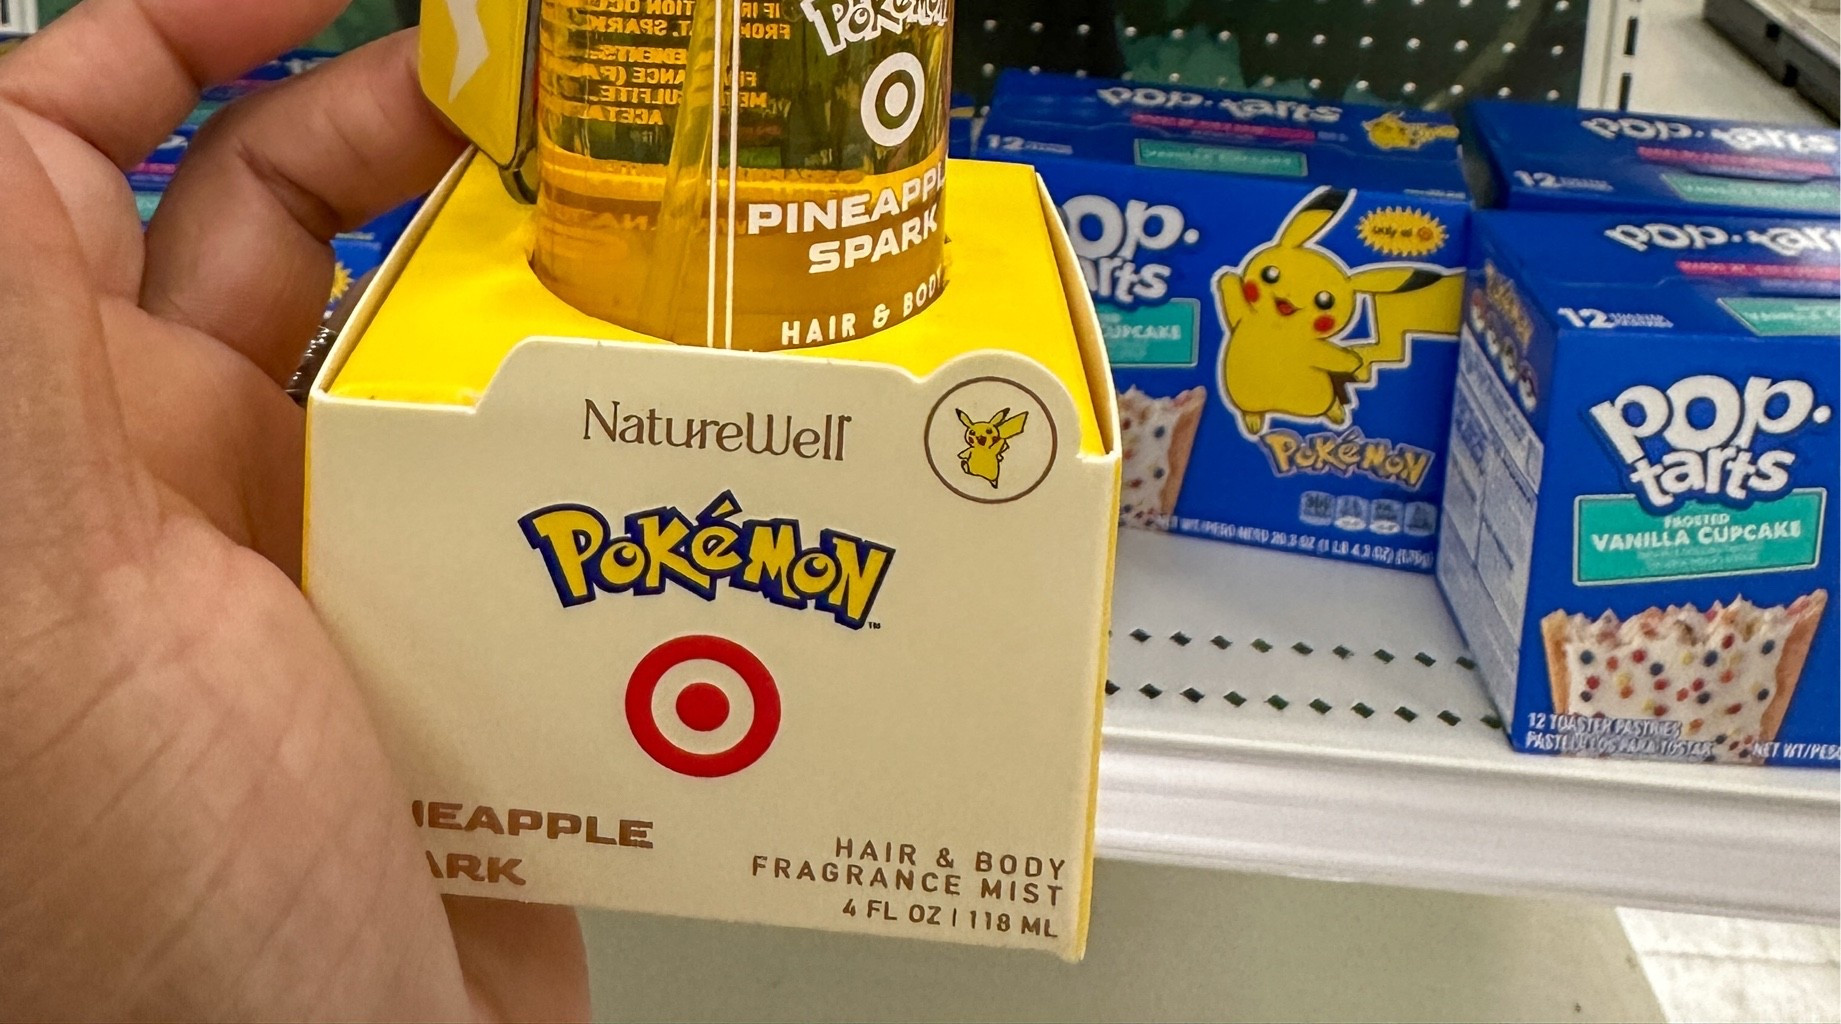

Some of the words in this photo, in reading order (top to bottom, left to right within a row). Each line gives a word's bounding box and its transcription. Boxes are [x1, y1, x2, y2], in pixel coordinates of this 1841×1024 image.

[747, 162, 947, 235] PINEAPPL
[808, 204, 938, 274] SPARK
[781, 312, 856, 346] HAIR
[872, 304, 890, 329] &
[1557, 307, 1613, 330] 12
[583, 398, 852, 462] NatureWell
[1258, 426, 1435, 493] Pokémon
[517, 490, 897, 631] Pokémon
[1590, 529, 1691, 552] VANILLA
[1697, 520, 1802, 544] CUPCAKE
[1527, 712, 1546, 730] 12
[413, 801, 655, 850] EAPPLE
[751, 855, 962, 897] FRAGRANCE
[980, 877, 1065, 908] MIST
[834, 836, 918, 867] HAIR
[935, 845, 955, 869] &
[974, 850, 1067, 881] BODY
[841, 902, 858, 919] 4
[866, 900, 897, 921] FL
[908, 905, 942, 926] OZ
[968, 910, 1011, 933] 118
[1020, 915, 1059, 938] ML
